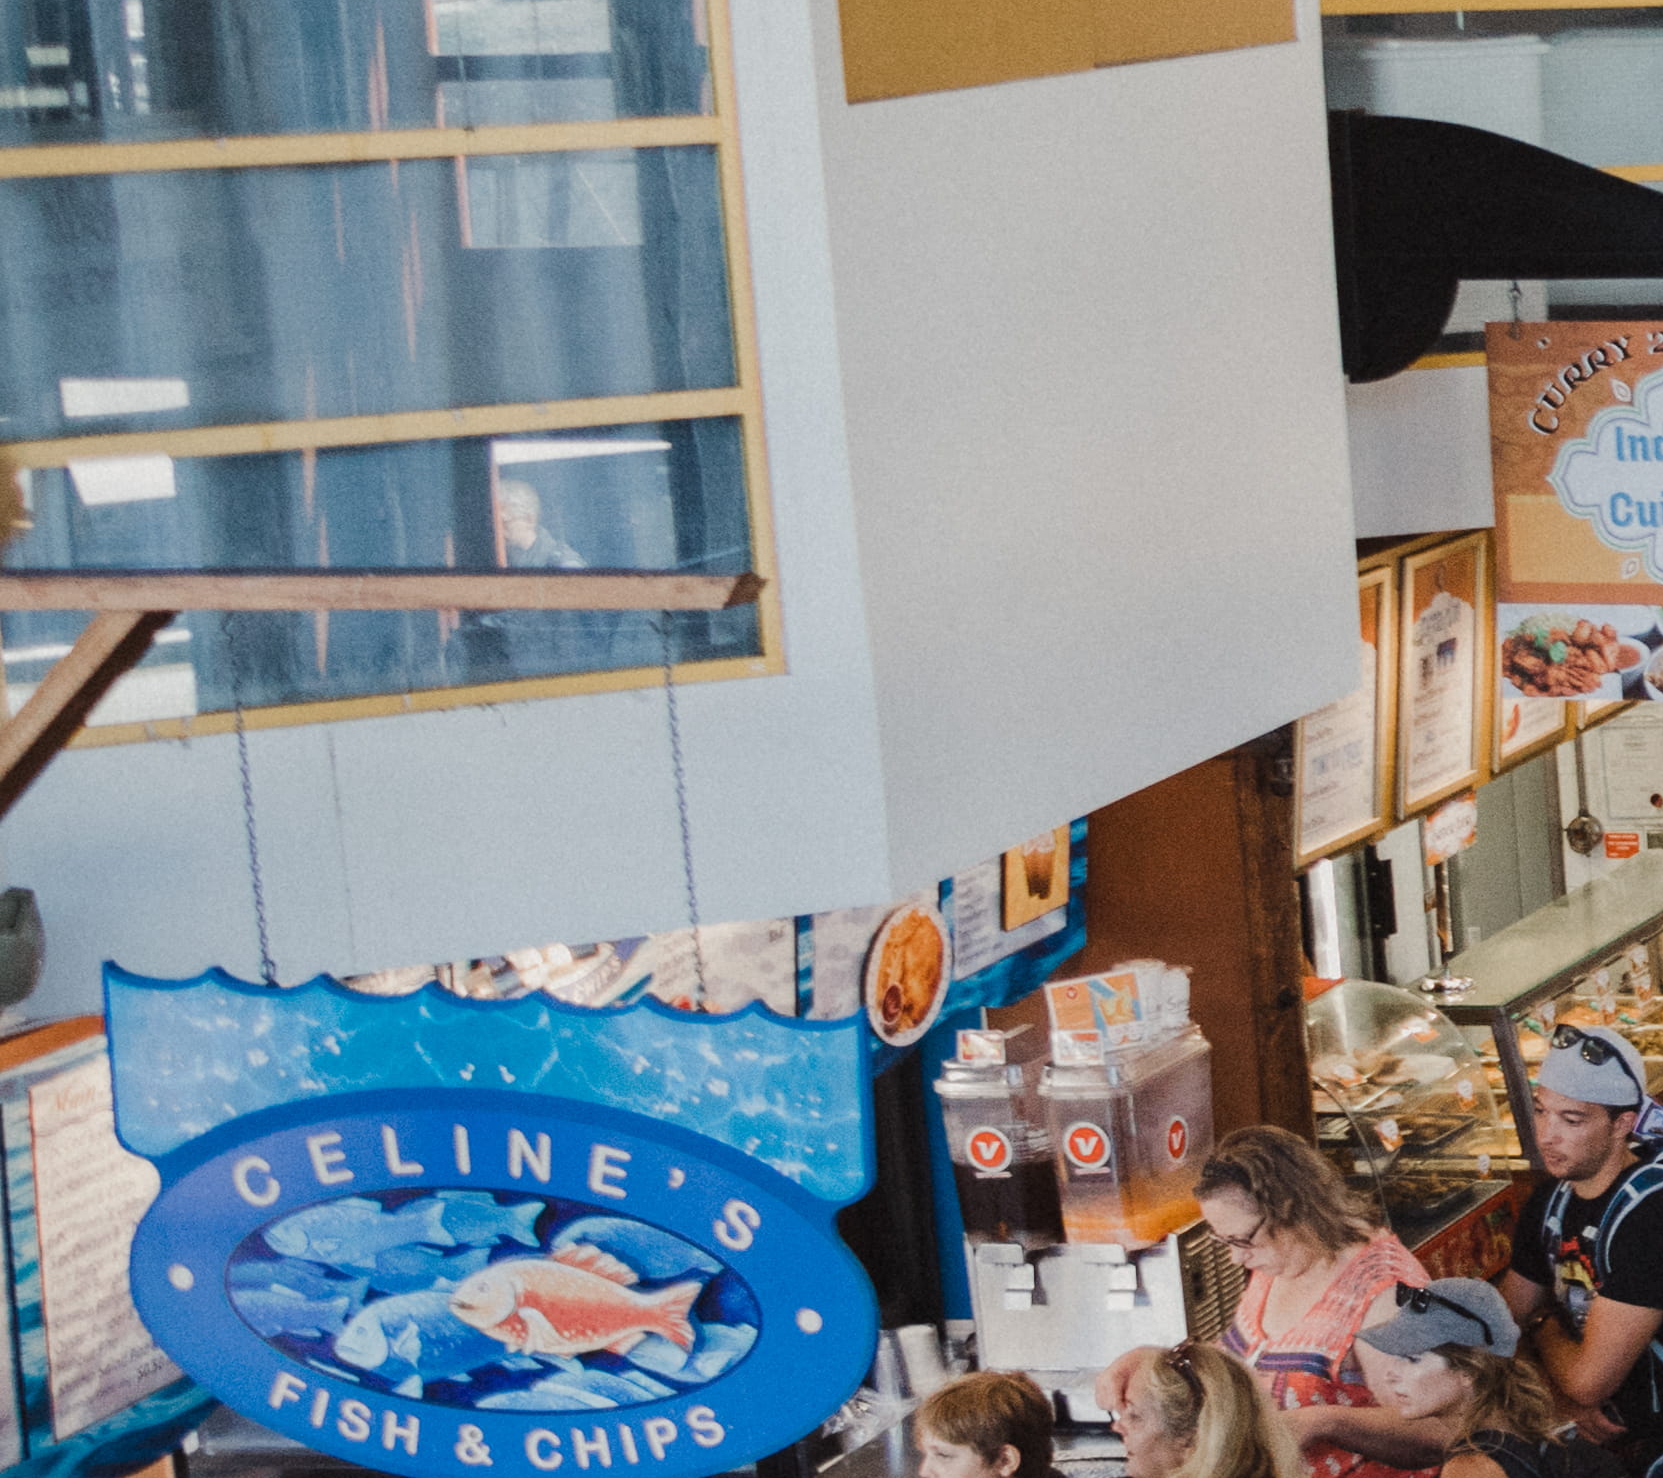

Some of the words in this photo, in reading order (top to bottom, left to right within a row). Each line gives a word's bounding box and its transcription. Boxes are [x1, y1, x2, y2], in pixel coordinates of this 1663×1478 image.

[1527, 335, 1634, 436] CURRY
[231, 1123, 761, 1251] CELINE'S
[269, 1372, 421, 1456] FISH
[454, 1423, 494, 1467] &
[524, 1406, 726, 1471] CHIPS
